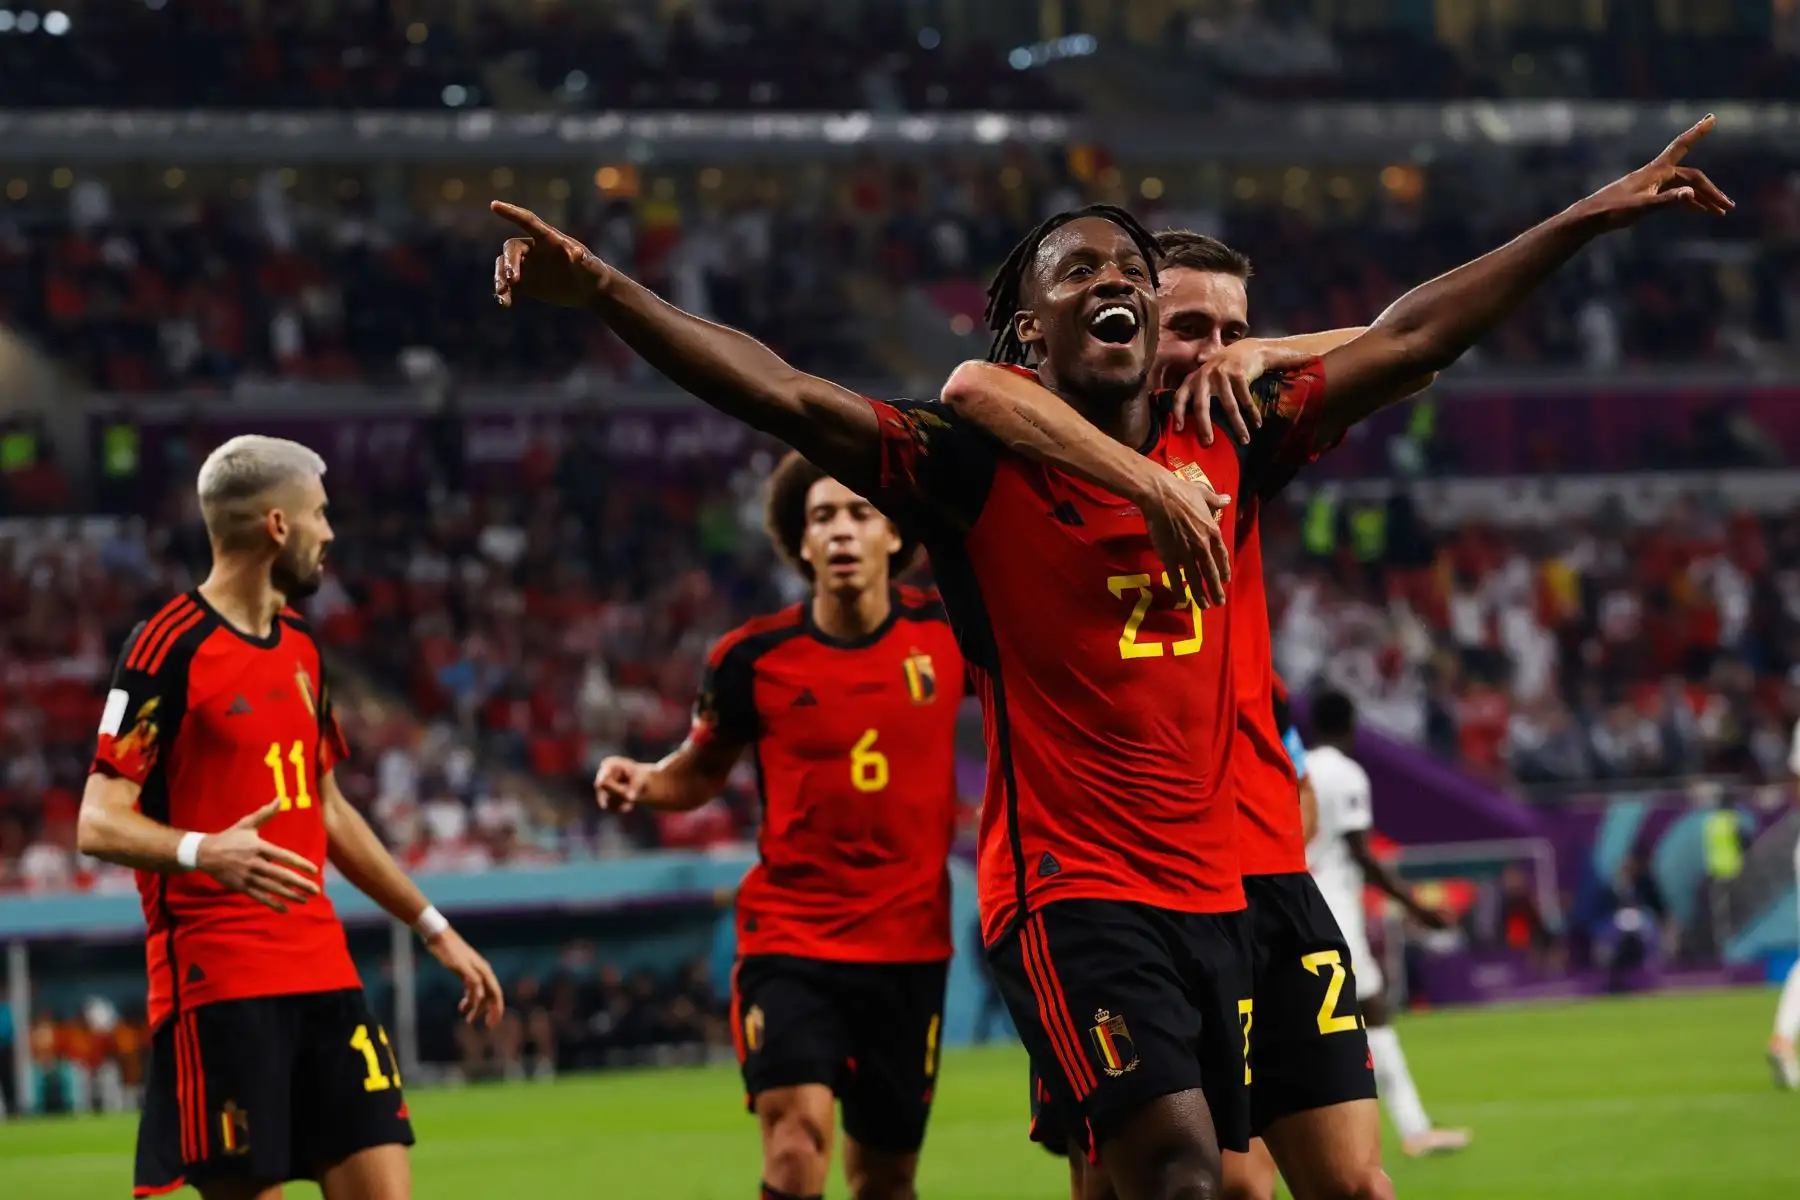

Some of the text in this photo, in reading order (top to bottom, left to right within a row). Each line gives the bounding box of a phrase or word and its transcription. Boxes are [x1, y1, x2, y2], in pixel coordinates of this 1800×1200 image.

[264, 739, 312, 812] 11
[850, 729, 889, 792] 6
[1301, 950, 1366, 1036] 2
